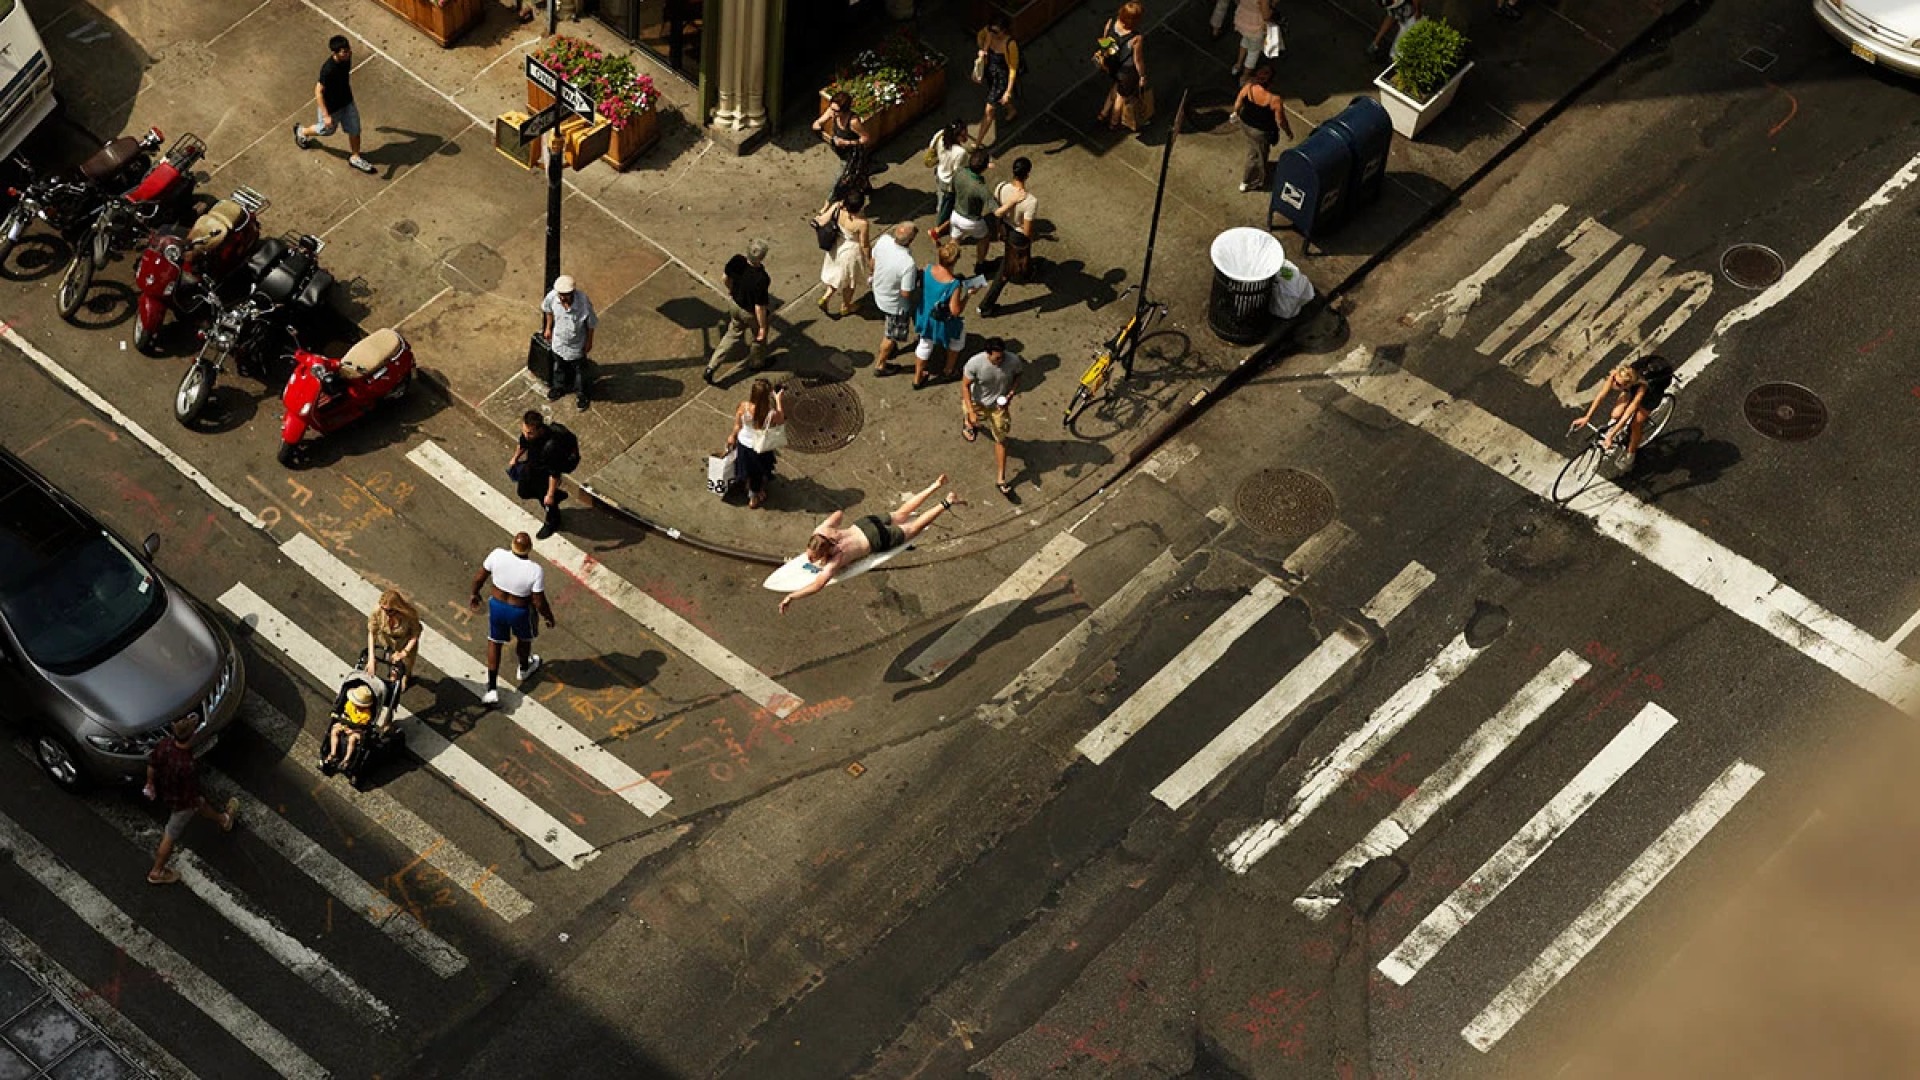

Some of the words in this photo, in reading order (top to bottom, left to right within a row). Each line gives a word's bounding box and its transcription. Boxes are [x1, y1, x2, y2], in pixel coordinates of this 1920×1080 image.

[535, 67, 556, 91] ONE
[562, 86, 585, 108] WAY
[1412, 203, 1713, 409] ONLY
